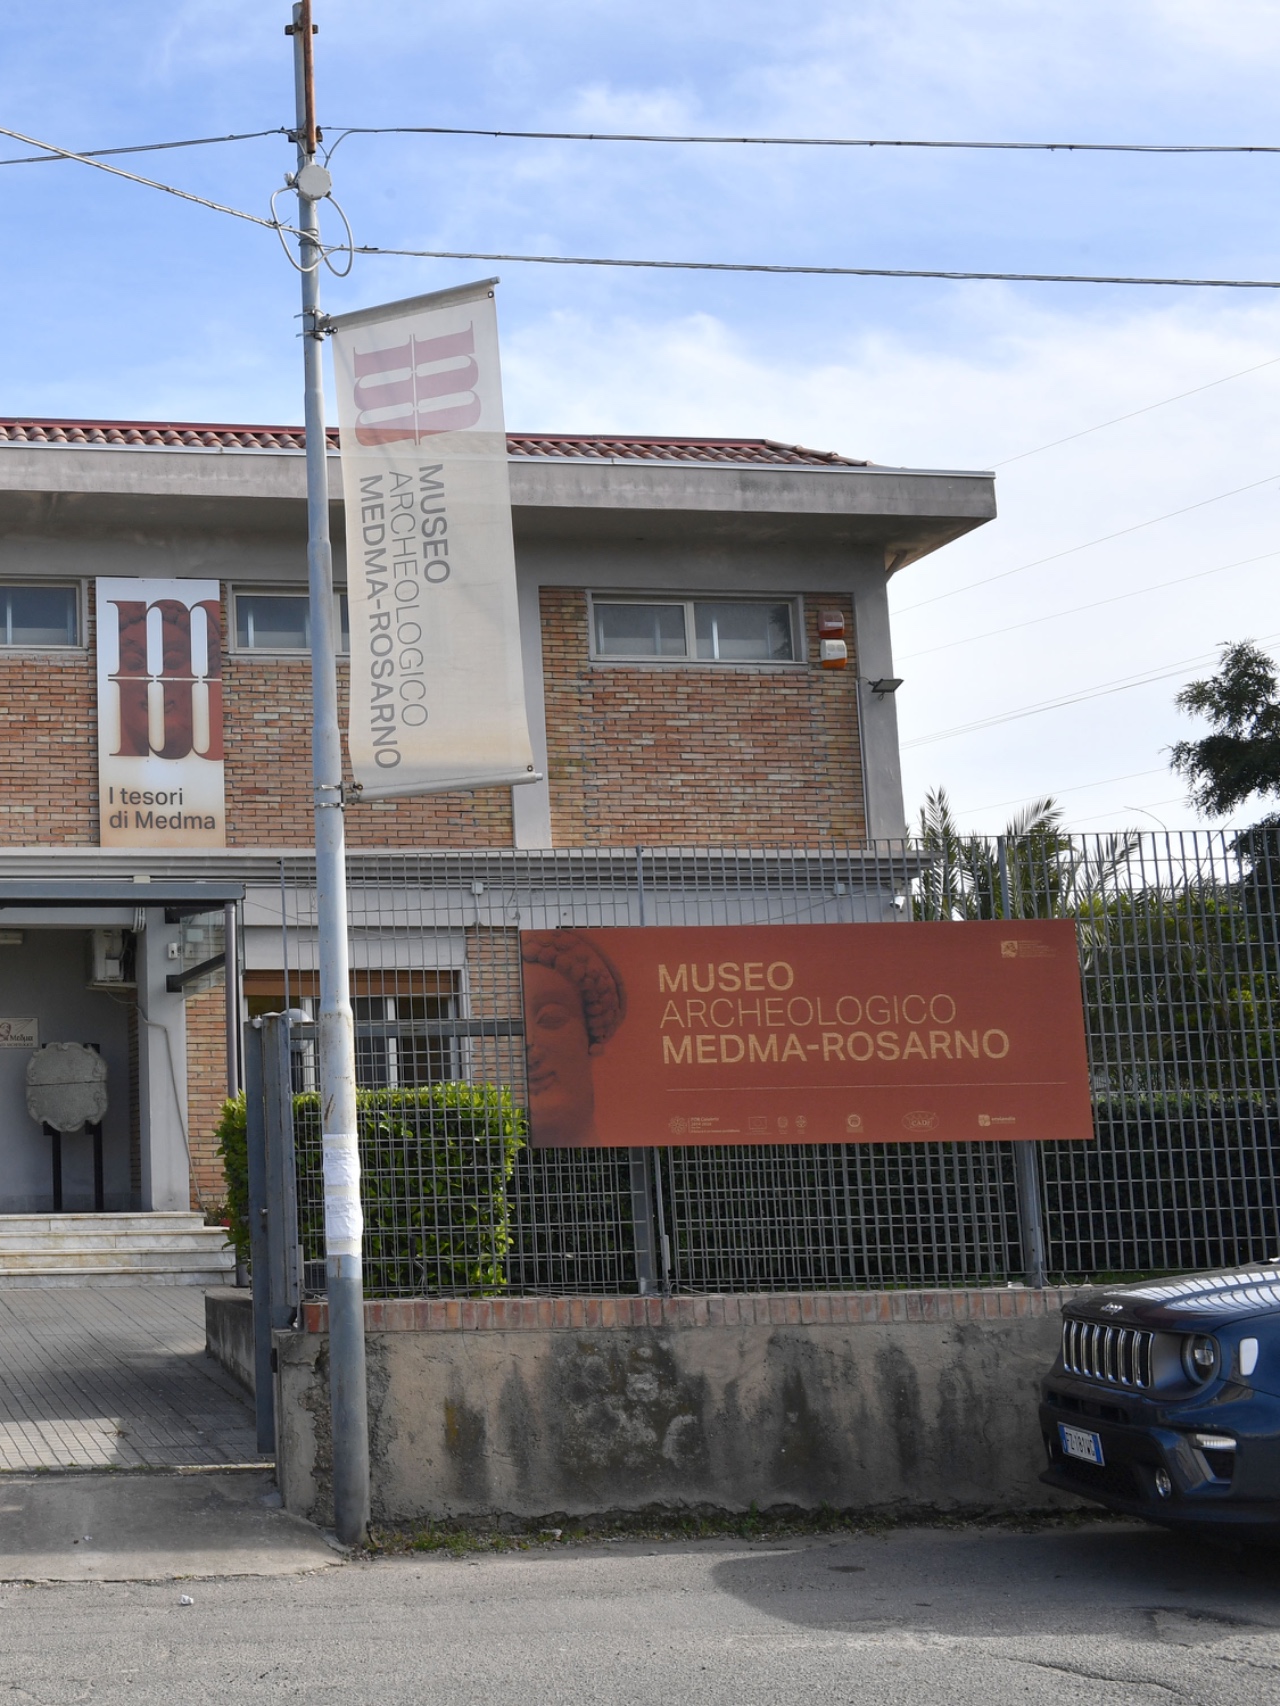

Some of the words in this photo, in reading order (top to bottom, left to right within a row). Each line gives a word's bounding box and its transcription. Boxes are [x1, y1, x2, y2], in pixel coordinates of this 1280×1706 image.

[418, 464, 451, 585] MUSEO
[388, 471, 429, 728] ARCHEOLOGICO
[359, 474, 402, 770] MEDMA-ROSARNO
[108, 786, 114, 805] I
[119, 787, 184, 806] tesori
[108, 810, 129, 830] di
[135, 810, 216, 831] Medma
[657, 960, 795, 995] MUSEO
[659, 993, 957, 1029] ARCHEOLOGICO
[663, 1027, 1011, 1065] MEDMA-ROSARNO
